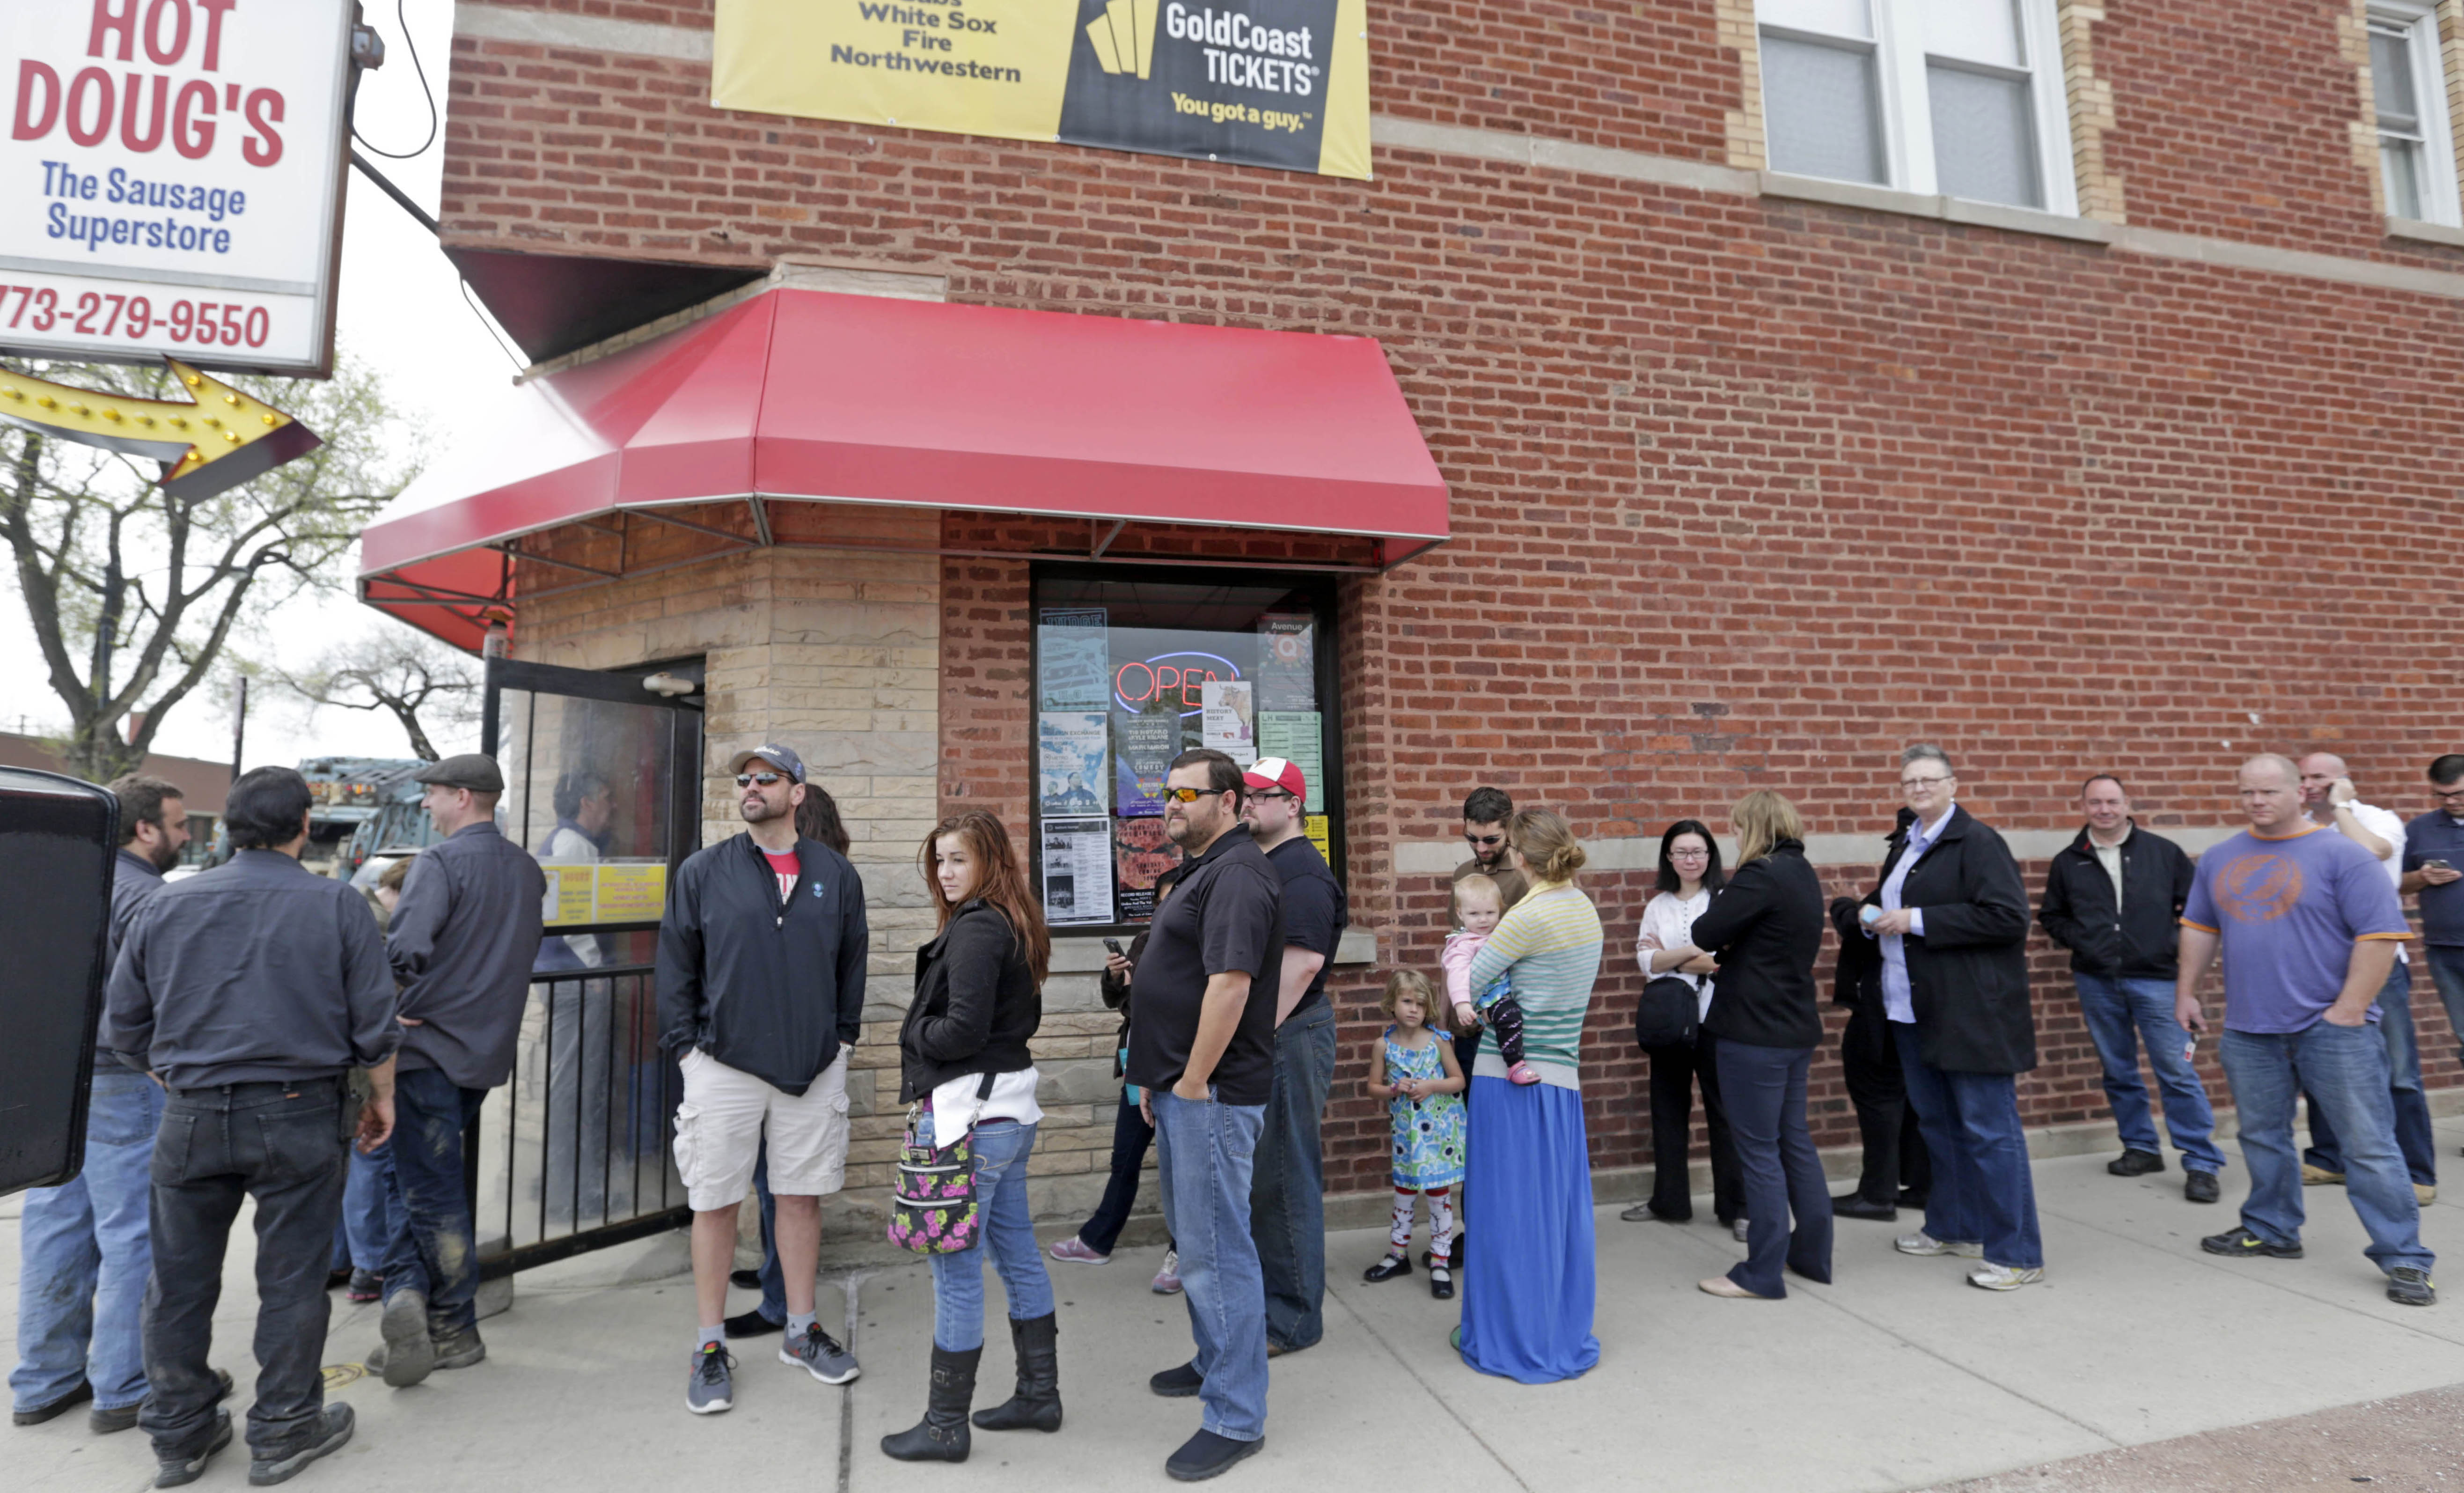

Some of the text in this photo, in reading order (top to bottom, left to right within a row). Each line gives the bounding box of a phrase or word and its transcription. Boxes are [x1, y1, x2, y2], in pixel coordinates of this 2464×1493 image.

[86, 0, 237, 72] HOT
[859, 2, 997, 34] White Sox
[902, 29, 952, 51] Fire
[1166, 2, 1313, 59] GoldCoast
[831, 44, 1021, 82] Northwestern
[12, 59, 285, 168] DOUG'S
[1171, 91, 1209, 117] You
[1211, 103, 1246, 124] got
[1247, 108, 1260, 124] a
[41, 160, 245, 222] The Sausage
[47, 202, 231, 253] Superstore
[1278, 637, 1297, 657] Q
[1117, 662, 1234, 706] OPE
